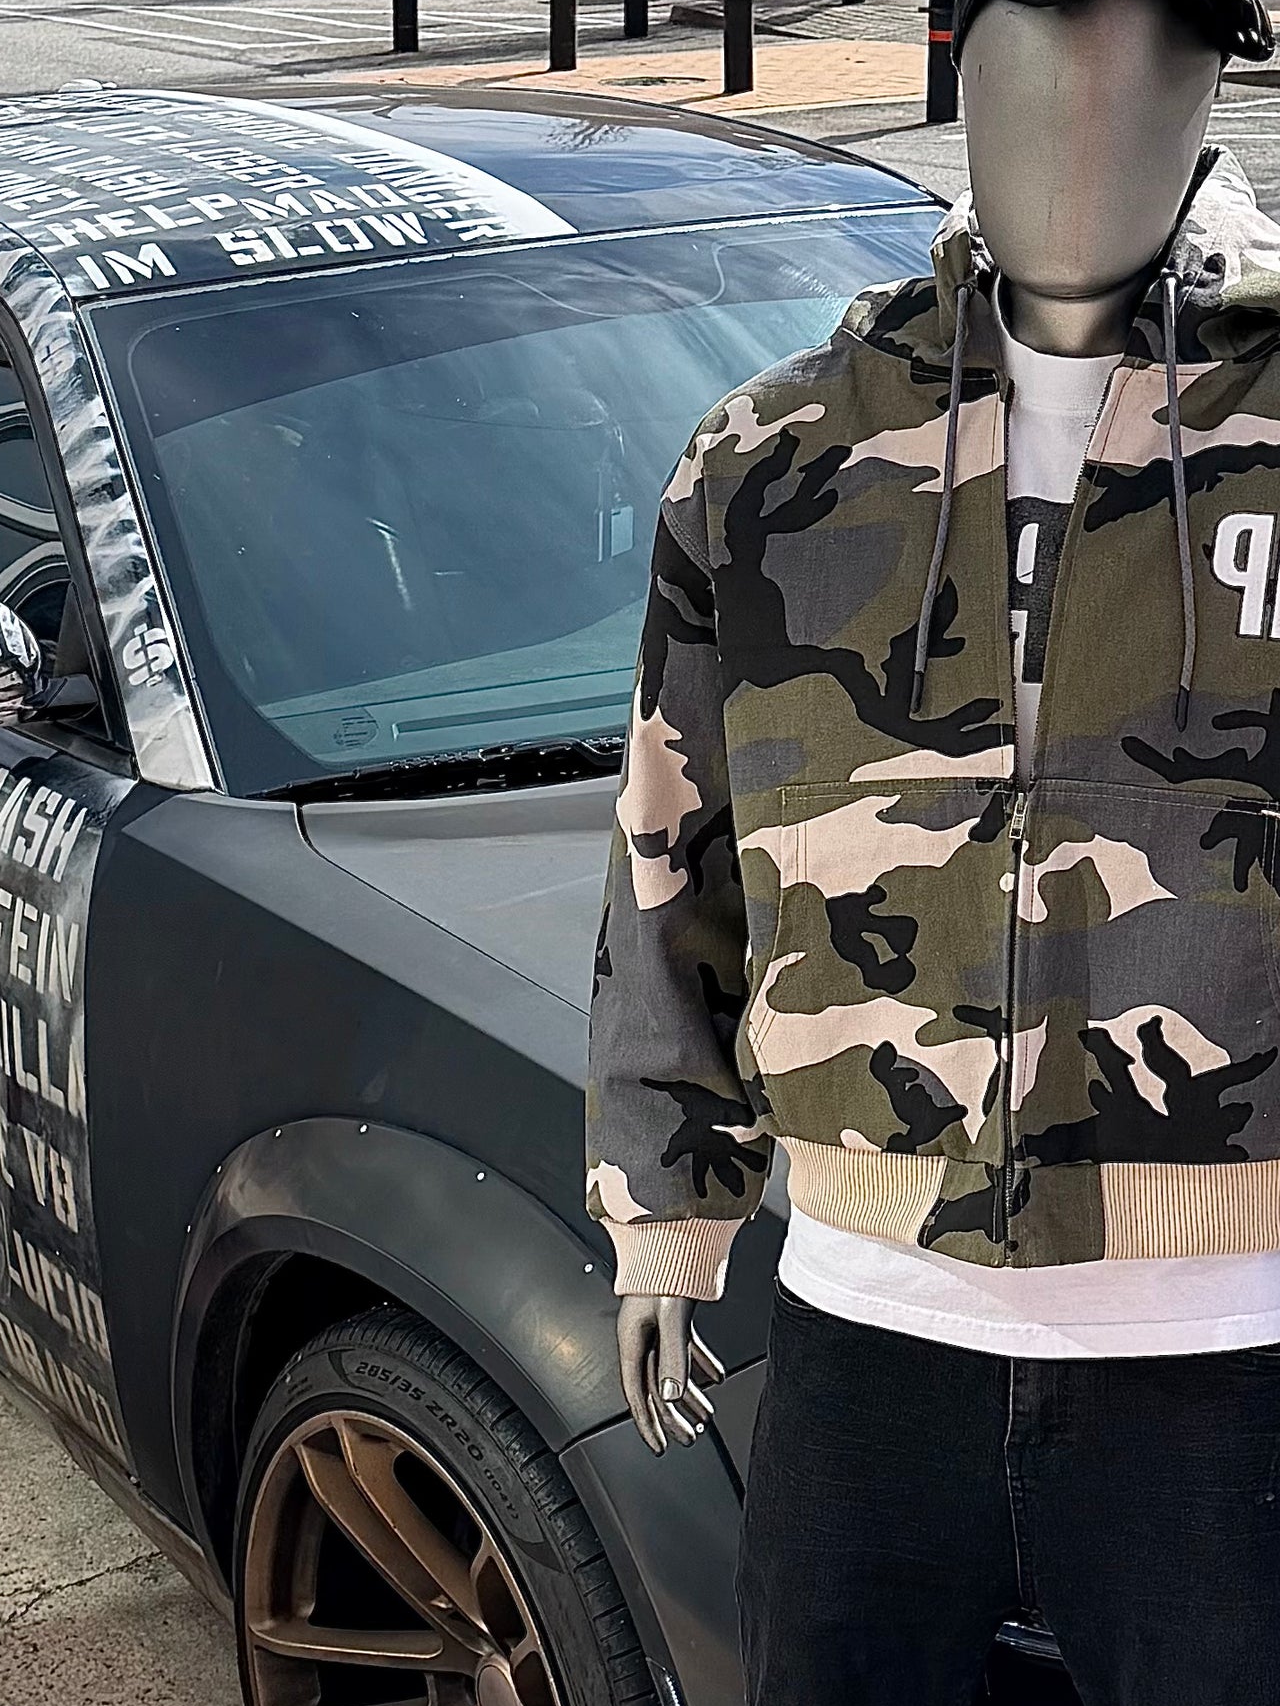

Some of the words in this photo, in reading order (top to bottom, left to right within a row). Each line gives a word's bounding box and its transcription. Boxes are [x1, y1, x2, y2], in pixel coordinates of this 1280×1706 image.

[44, 192, 239, 247] HELP
[238, 182, 411, 222] MAD
[76, 242, 178, 291] IM
[213, 210, 429, 267] SLOW
[18, 1121, 81, 1235] V8
[425, 1399, 485, 1463] ZR20
